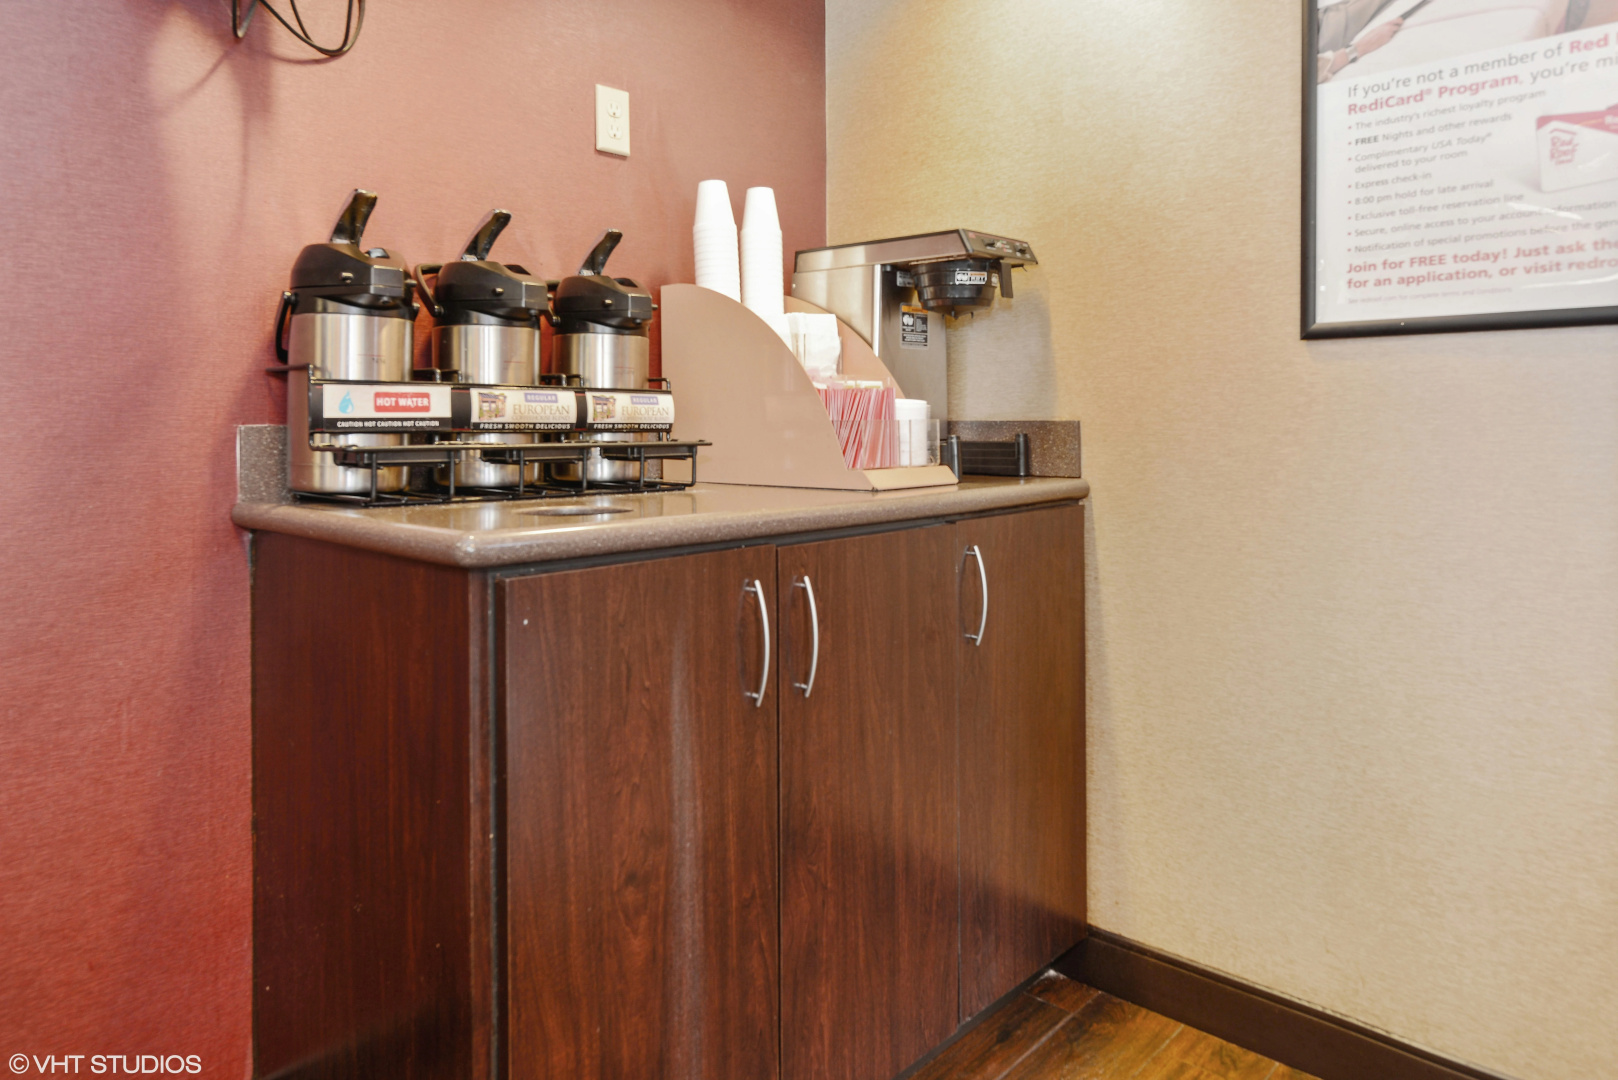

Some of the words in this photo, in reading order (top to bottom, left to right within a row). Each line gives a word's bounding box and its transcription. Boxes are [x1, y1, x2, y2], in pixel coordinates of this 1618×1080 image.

[1348, 84, 1359, 98] If
[1363, 78, 1411, 98] you're
[1416, 69, 1443, 84] not
[1449, 68, 1459, 78] a
[1464, 50, 1537, 75] member
[1543, 42, 1563, 59] of
[1569, 33, 1609, 54] Red
[1530, 61, 1589, 85] you're
[1356, 121, 1372, 130] The
[1423, 106, 1456, 118] richest
[1459, 99, 1494, 112] loyalty
[1498, 90, 1546, 106] program
[1355, 135, 1380, 146] FREE
[1382, 130, 1413, 142] Nights
[1416, 125, 1435, 136] and
[1438, 121, 1465, 132] other
[1469, 113, 1512, 127] rewards
[1355, 144, 1428, 162] Complimentary
[1432, 140, 1452, 150] USA
[1355, 160, 1398, 174] delivered
[1402, 158, 1412, 167] to
[1415, 155, 1437, 167] your
[1440, 150, 1468, 161] room
[1355, 179, 1389, 190] Express
[1391, 172, 1432, 184] check-in
[1377, 194, 1392, 204] pm
[1395, 190, 1417, 200] hold
[1420, 188, 1435, 196] for
[1438, 185, 1457, 194] late
[1461, 179, 1494, 191] arrival
[1355, 210, 1397, 221] Exclusive
[1399, 204, 1439, 216] toll-free
[1442, 195, 1501, 210] reservation
[1504, 194, 1524, 203] line
[1391, 222, 1422, 233] online
[1424, 219, 1455, 229] access
[1458, 217, 1469, 225] to
[1472, 214, 1496, 226] your
[1355, 240, 1411, 253] Notification
[1414, 238, 1425, 247] of
[1428, 234, 1462, 246] special
[1464, 228, 1527, 243] promotions
[1571, 221, 1591, 231] the
[1347, 261, 1377, 274] Join
[1382, 258, 1405, 270] for
[1409, 254, 1447, 268] FREE
[1453, 248, 1507, 264] today!
[1514, 245, 1549, 259] Just
[1555, 241, 1586, 254] ask
[1347, 277, 1369, 289] for
[1373, 278, 1392, 287] an
[1397, 267, 1493, 287] application,
[1499, 266, 1517, 277] or
[1523, 261, 1562, 275] visit
[376, 397, 396, 407] HOT
[398, 397, 429, 408] WATER
[513, 404, 570, 415] EUROPEAN
[621, 406, 669, 417] EUROPEAN
